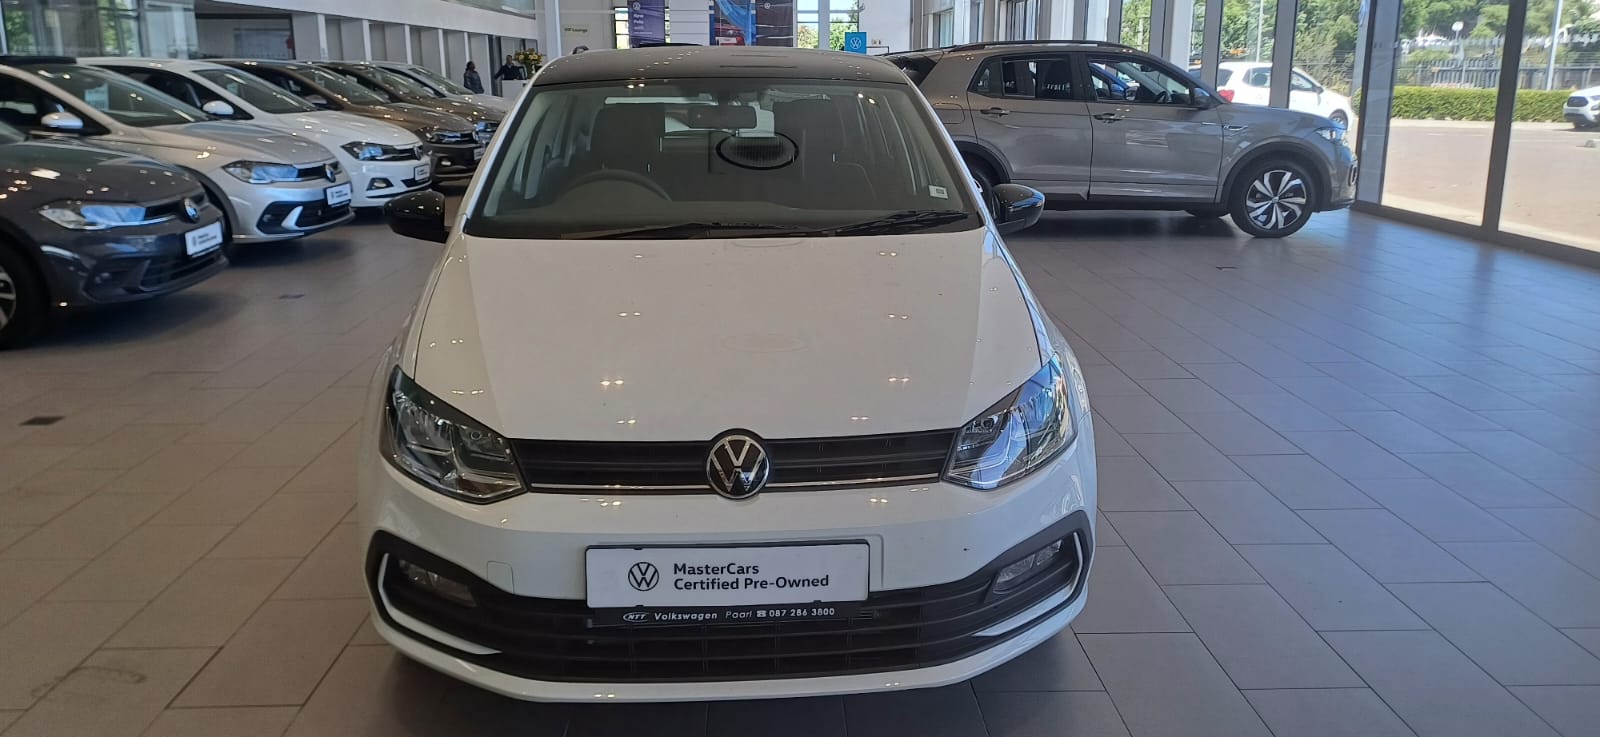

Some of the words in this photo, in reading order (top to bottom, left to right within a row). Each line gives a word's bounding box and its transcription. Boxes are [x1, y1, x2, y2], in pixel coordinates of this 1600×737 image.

[673, 562, 760, 575] MasterCars
[673, 577, 740, 590] Certified
[744, 574, 829, 589] Pre-Owned
[654, 611, 718, 621] Volkswagen
[725, 610, 753, 619] Paarl
[769, 609, 787, 617] 087
[790, 608, 808, 617] 286
[811, 607, 835, 616] 3800
